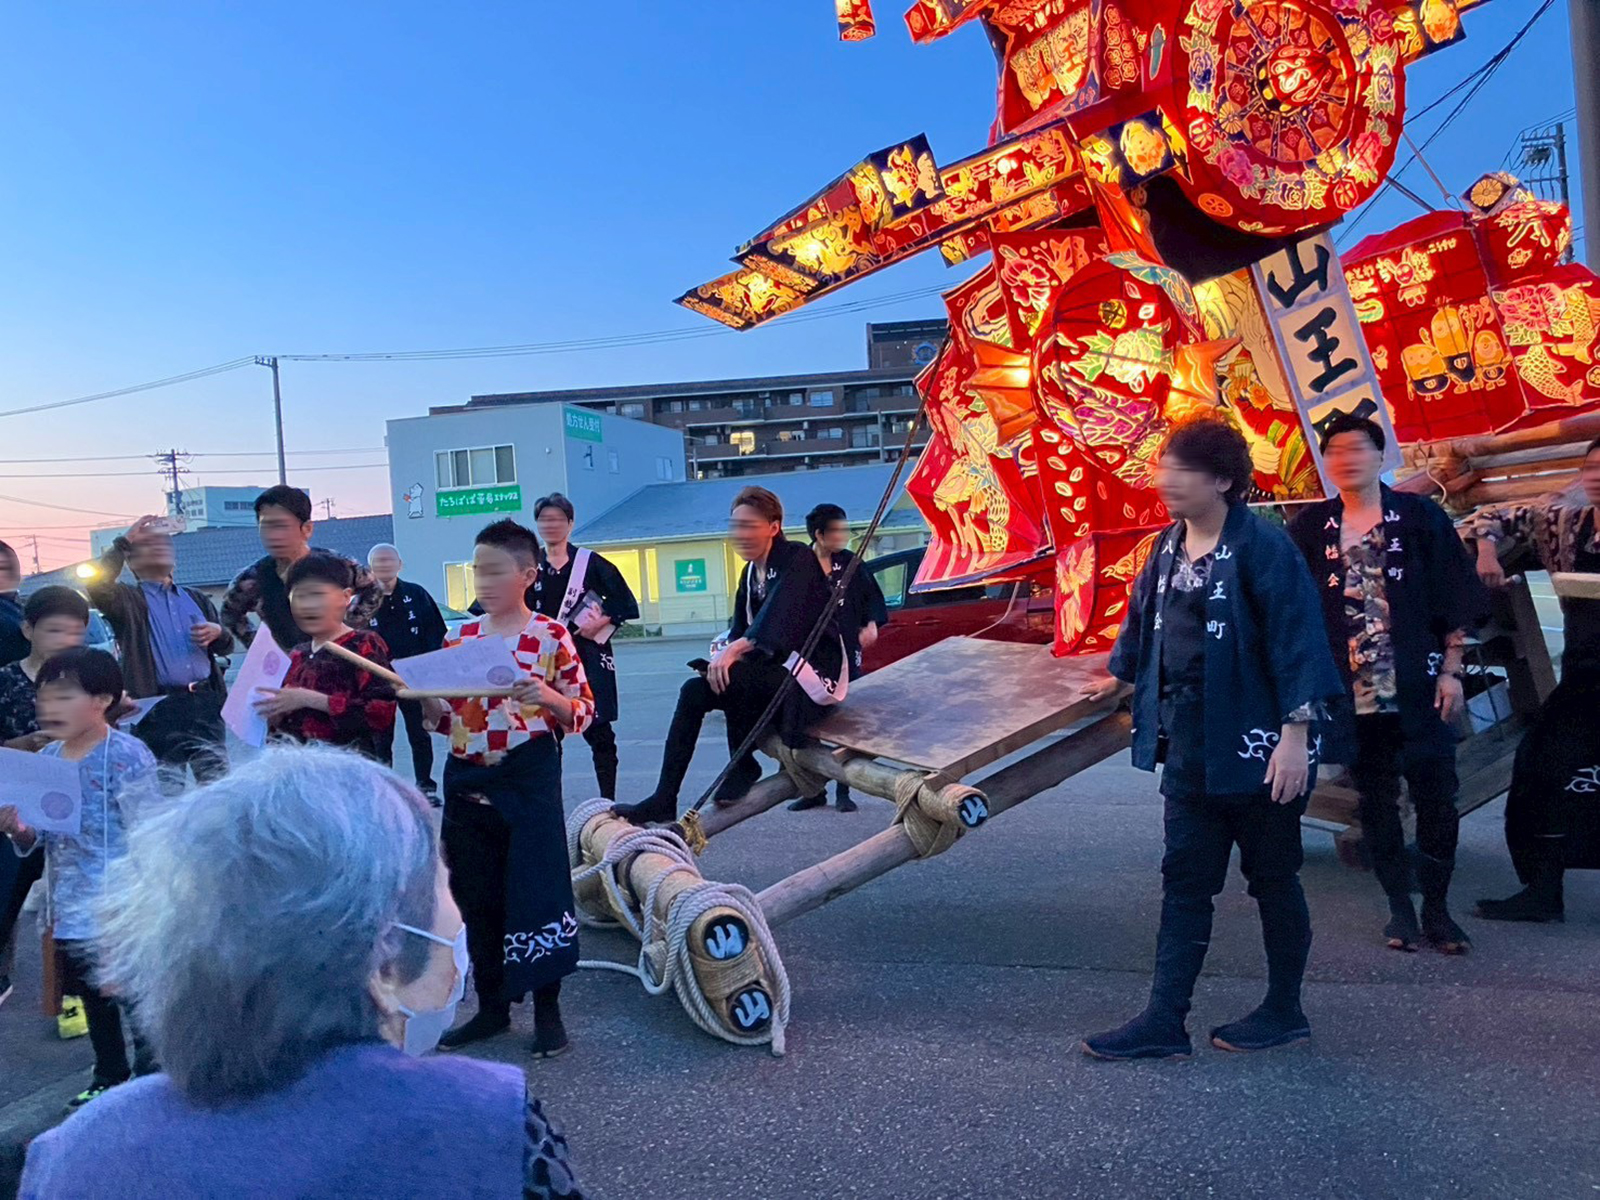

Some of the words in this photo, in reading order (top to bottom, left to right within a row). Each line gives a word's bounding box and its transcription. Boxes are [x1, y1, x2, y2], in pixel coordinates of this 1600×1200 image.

[1384, 509, 1404, 581] 山王町
[402, 595, 419, 635] 山王町
[1206, 544, 1233, 640] 山王町
